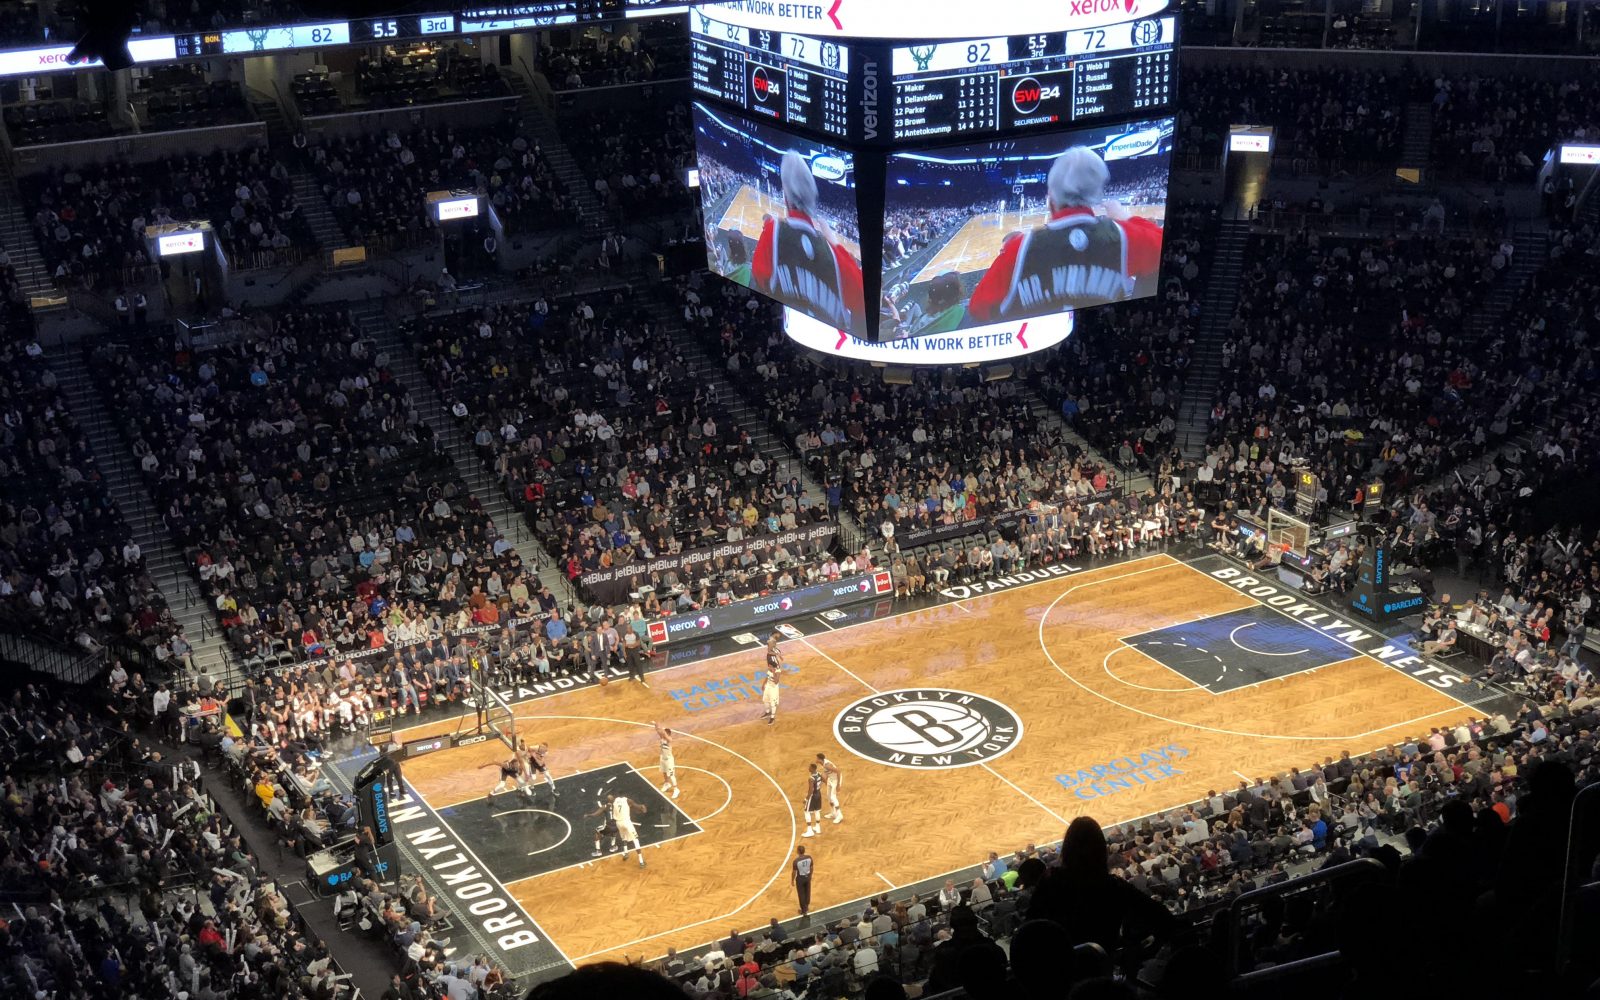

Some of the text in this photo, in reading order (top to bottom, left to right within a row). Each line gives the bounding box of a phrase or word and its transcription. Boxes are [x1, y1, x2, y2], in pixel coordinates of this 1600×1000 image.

[746, 0, 775, 16] WORK
[778, 4, 823, 20] BETTER
[1070, 0, 1119, 16] xerox
[373, 21, 398, 38] 5.5
[426, 18, 447, 33] 3rd
[194, 36, 200, 45] 5
[311, 27, 333, 43] 82
[1028, 35, 1046, 49] 5.5
[1084, 30, 1105, 50] 72
[791, 38, 804, 58] 72
[967, 43, 990, 63] 82
[1031, 49, 1044, 58] 3rd
[39, 53, 68, 65] xero
[1086, 63, 1103, 71] Webb
[1086, 73, 1107, 82] Russell
[754, 77, 779, 95] SW24
[904, 84, 925, 92] Maker
[1086, 83, 1113, 93] Stauskas
[859, 62, 878, 141] verizon
[1015, 86, 1060, 103] SW24
[1085, 96, 1097, 104] Acy
[904, 106, 926, 115] Parker
[1085, 105, 1104, 114] LeVert
[895, 119, 903, 127] 23
[904, 118, 925, 126] Brown
[958, 123, 966, 131] 14
[1111, 139, 1153, 152] ImperialDade
[892, 332, 1013, 351] CAN WORK BETTER
[580, 571, 612, 588] jetBlue
[614, 564, 646, 581] jetBlue
[647, 560, 678, 575] jetBlue
[681, 552, 712, 568] jetBlue
[713, 545, 743, 560] jetBlue
[808, 525, 837, 541] jetBlue
[1375, 549, 1383, 585] BARCLAYS
[876, 577, 889, 588] infor
[969, 562, 1083, 594] FANDUEL
[832, 583, 859, 597] xerox
[753, 601, 780, 615] xerox
[1390, 597, 1423, 611] BARCLAYS
[650, 627, 665, 638] infor
[669, 619, 697, 633] xerox
[1210, 567, 1466, 689] BROOKLYN NETS
[345, 646, 387, 659] HONDA
[461, 623, 501, 635] HONDA
[843, 691, 974, 733] BROOKLYN
[891, 709, 964, 748] B
[458, 735, 487, 746] GEICO
[888, 725, 1014, 766] NEW YORK
[1055, 744, 1189, 800] BARCLAYS CENTER
[374, 792, 388, 834] BARCLAYS
[405, 826, 540, 951] BROOKLYN
